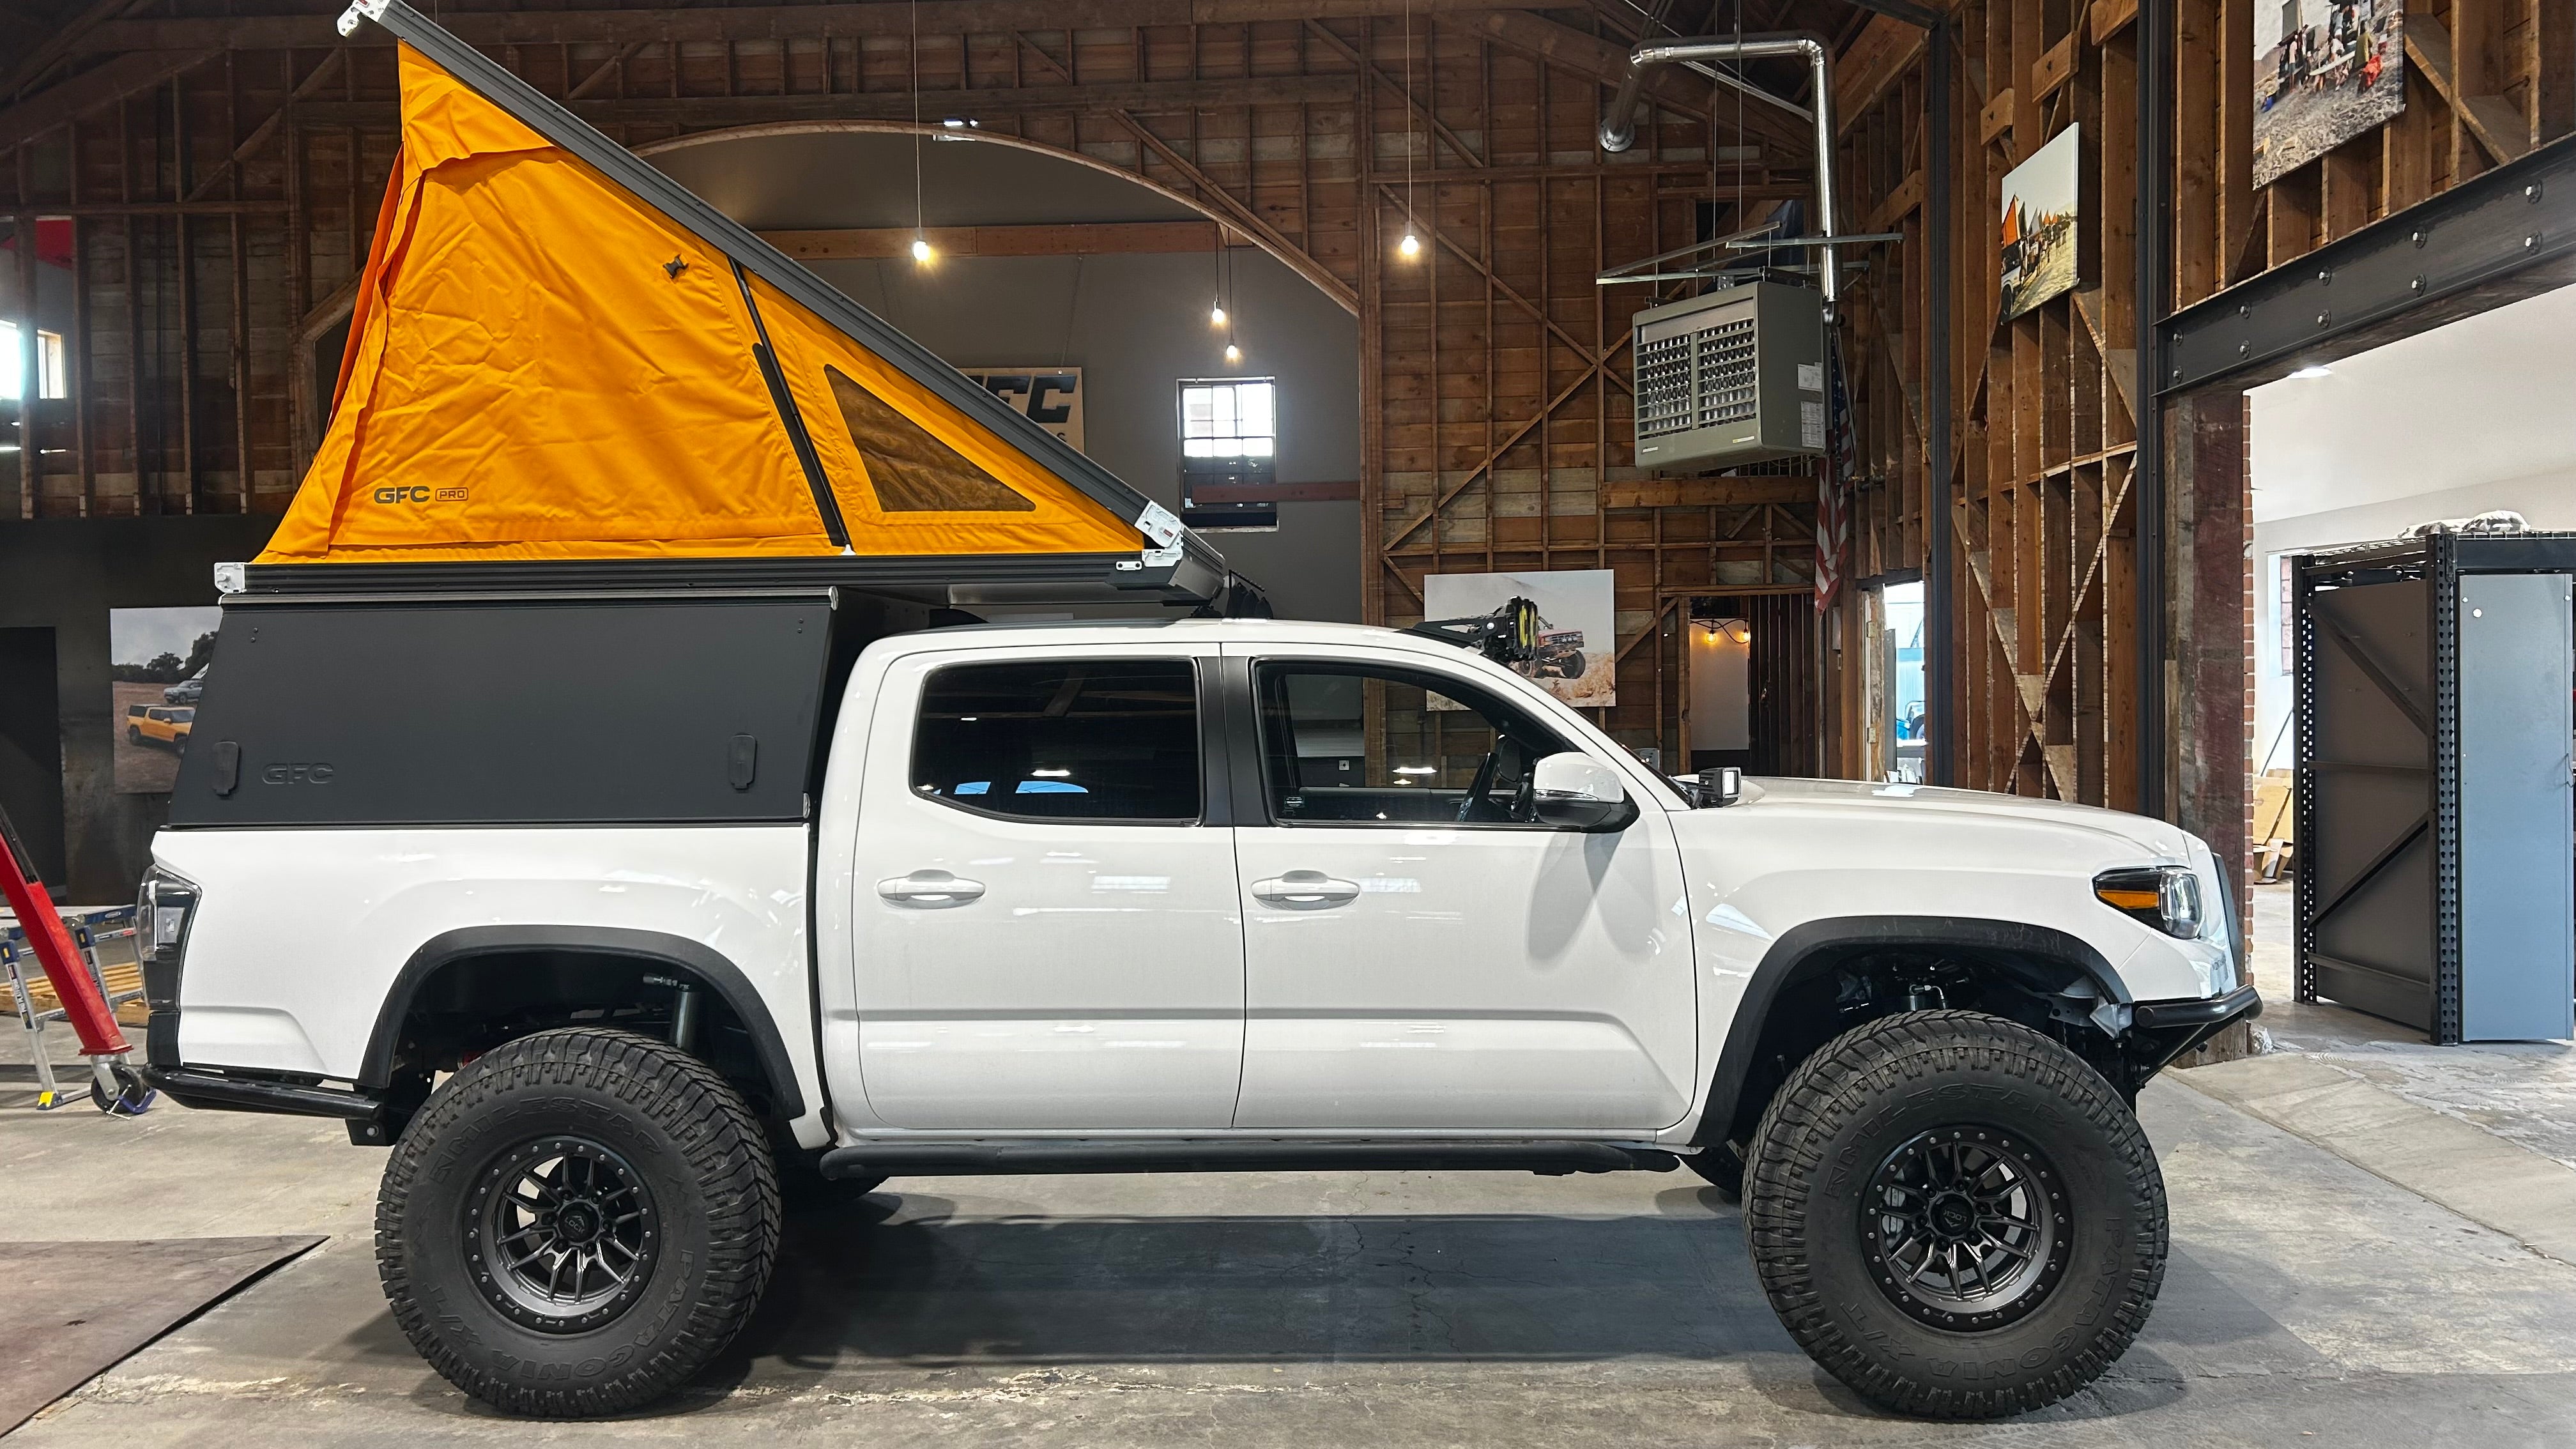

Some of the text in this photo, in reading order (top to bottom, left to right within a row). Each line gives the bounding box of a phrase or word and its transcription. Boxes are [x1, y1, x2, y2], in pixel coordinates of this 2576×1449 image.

[967, 375, 1077, 423] FC
[374, 486, 466, 503] GFC PRO
[262, 763, 333, 784] GFC
[451, 1096, 662, 1155] MILESTAR
[1837, 1082, 2066, 1164] MILESTAR
[423, 1248, 695, 1381] PATAGONIA X/T
[1839, 1217, 2124, 1382] PATAGONIA X/T
